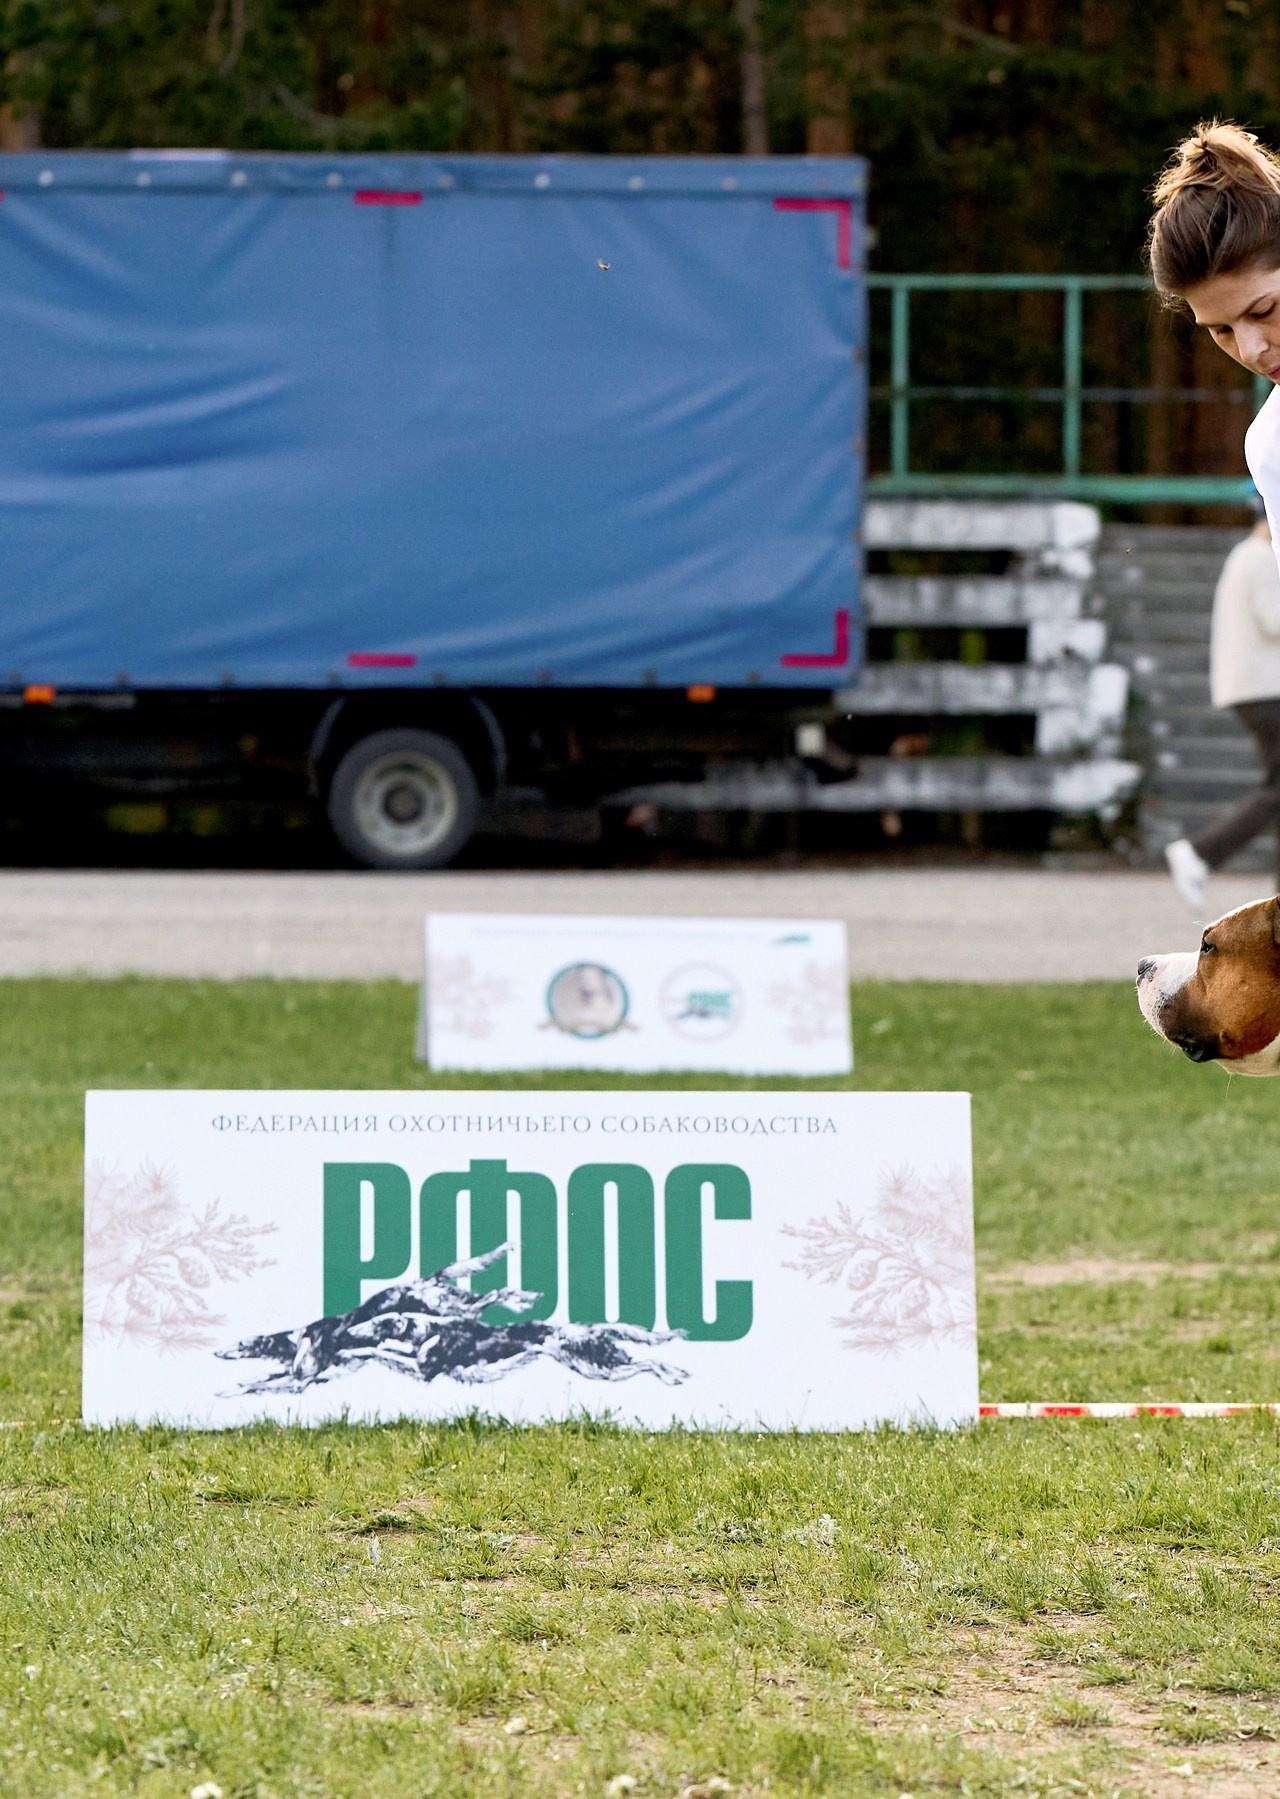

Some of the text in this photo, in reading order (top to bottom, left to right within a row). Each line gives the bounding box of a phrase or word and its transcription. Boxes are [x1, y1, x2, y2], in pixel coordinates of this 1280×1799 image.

[211, 1115, 838, 1136] ФЕДЕРАЦИЯ ОХОТНИЧЬЕГО СОБАКОВОДСТВА
[323, 1158, 754, 1342] РФОС
